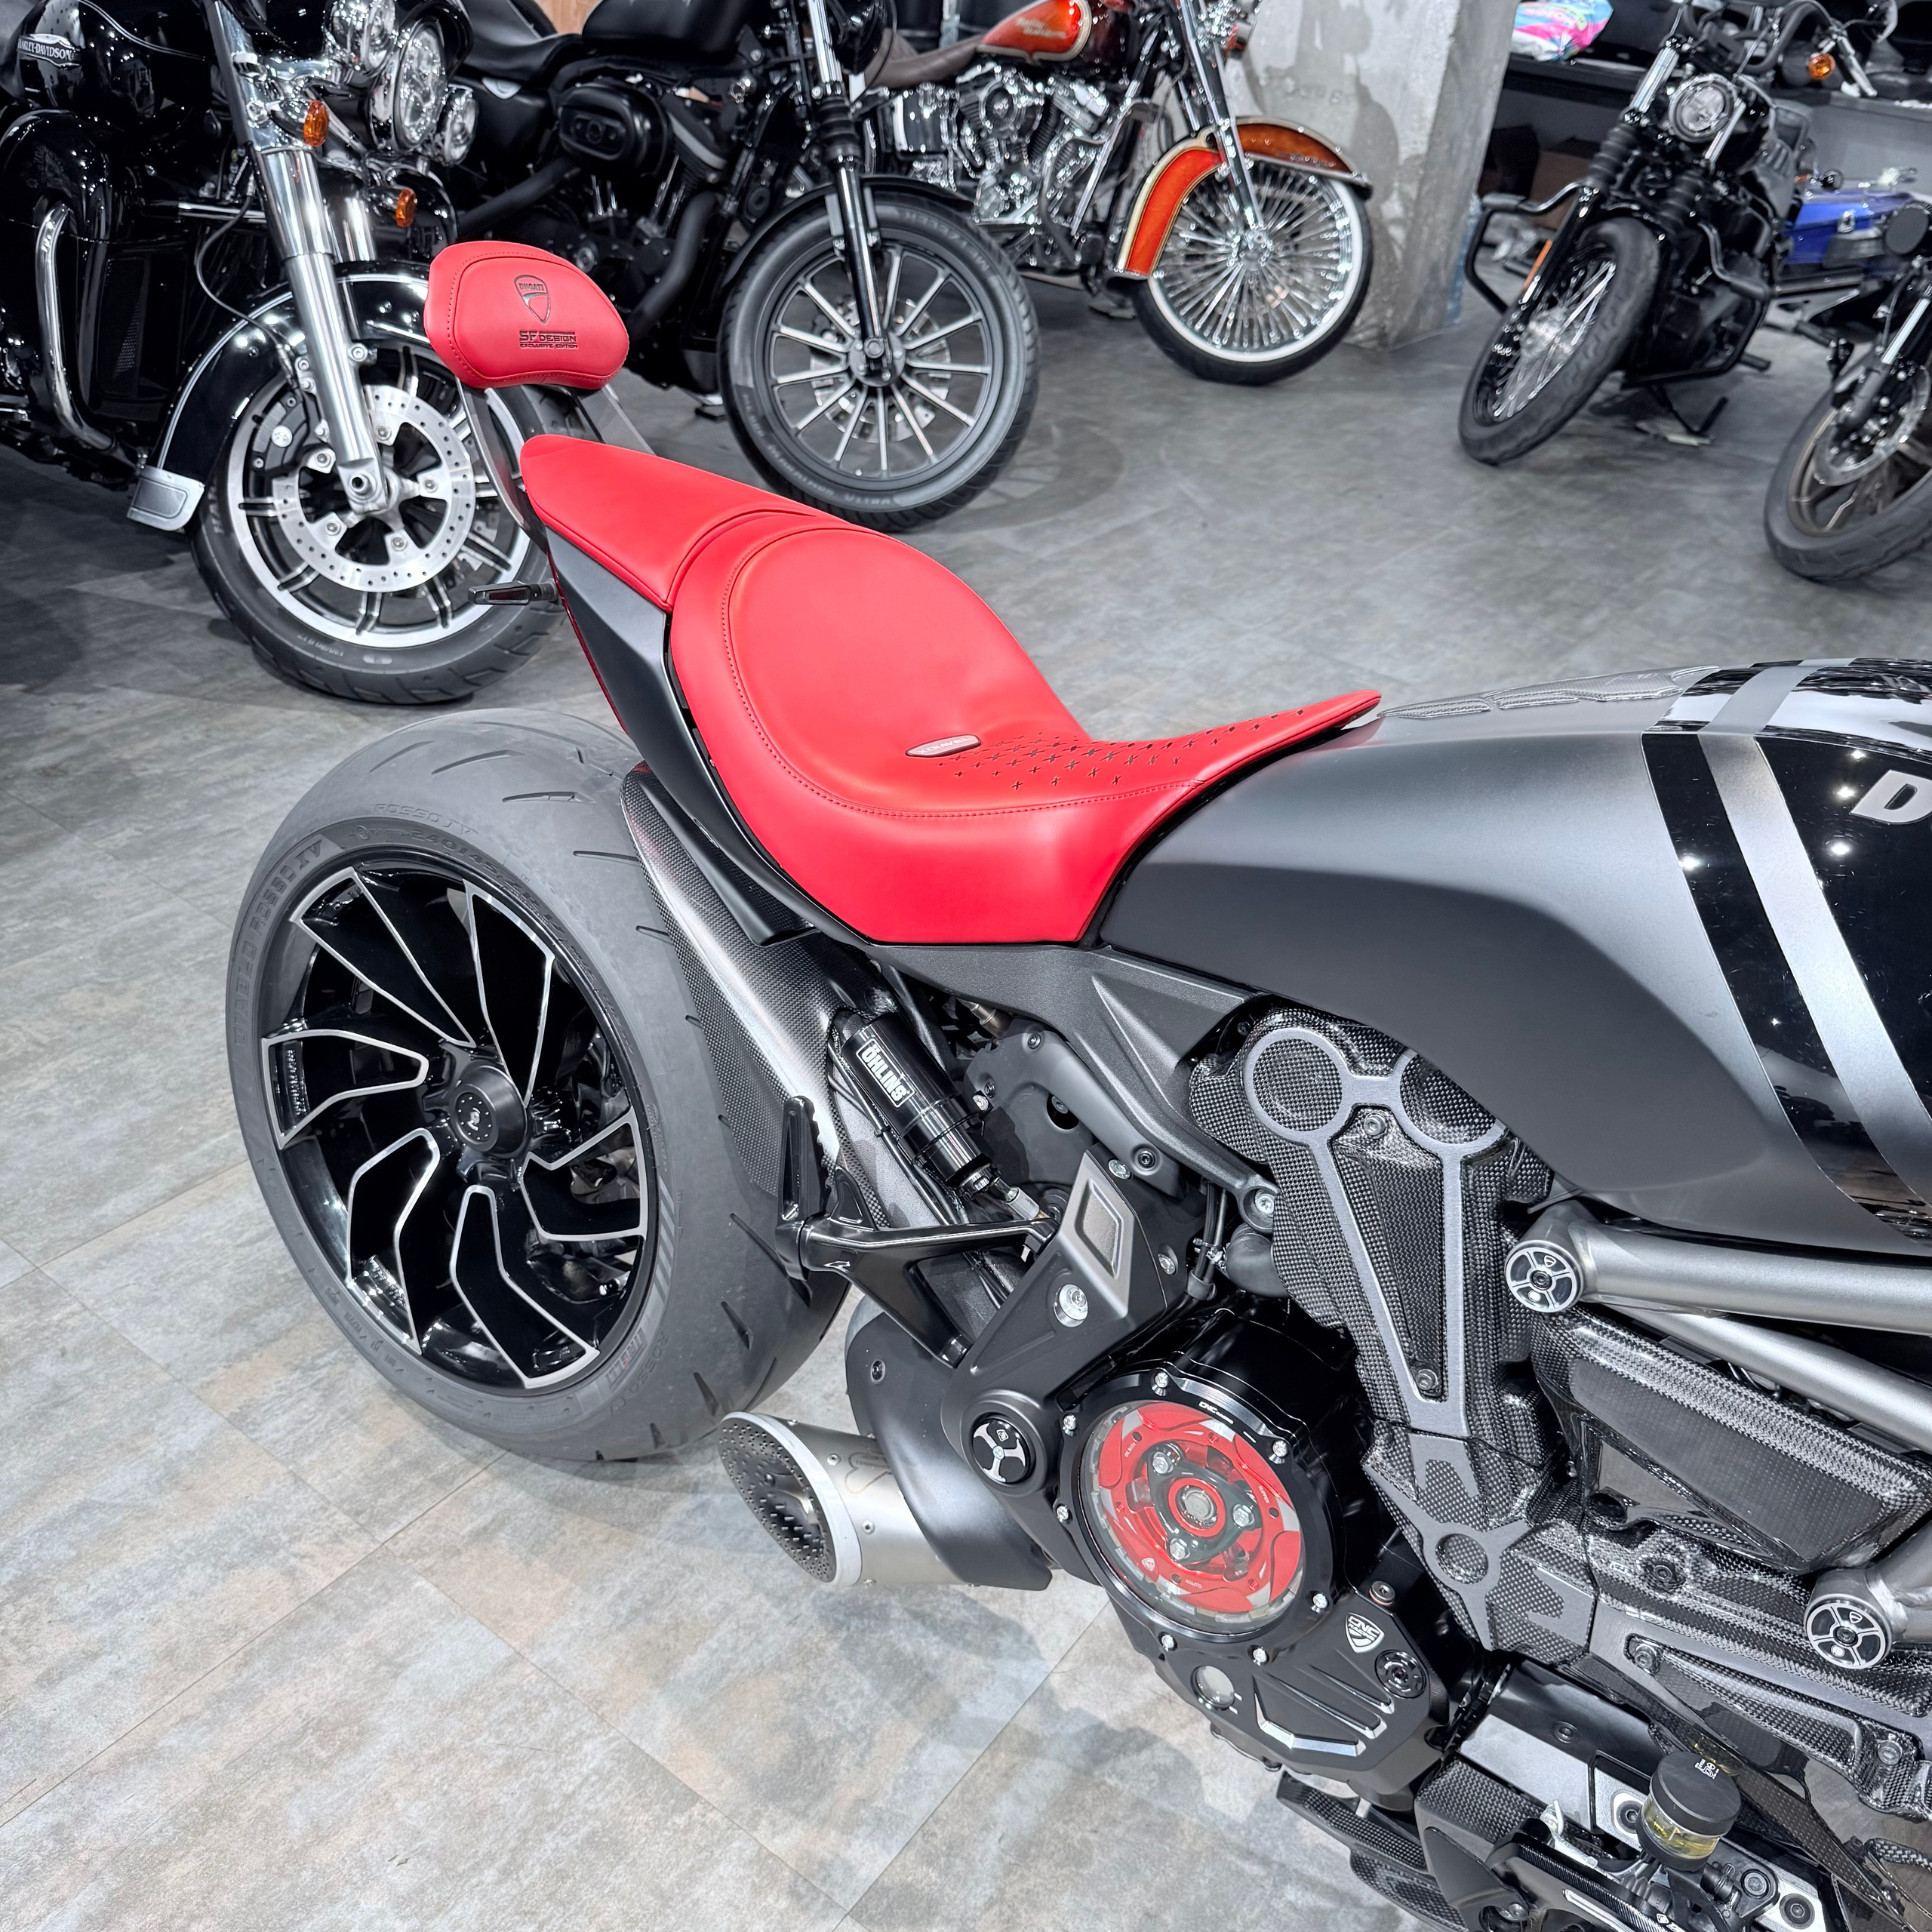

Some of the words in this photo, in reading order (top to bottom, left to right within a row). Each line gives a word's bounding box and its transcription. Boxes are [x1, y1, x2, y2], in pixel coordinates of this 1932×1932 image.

[518, 283, 544, 291] DUCATI
[519, 331, 537, 342] SF
[373, 802, 443, 823] ROSSO
[232, 940, 258, 1047] DIABLO
[248, 863, 298, 937] ROSSO
[861, 1043, 908, 1102] ÖHLINS
[605, 1326, 650, 1393] PIRELLI
[1198, 1401, 1218, 1414] CNC
[1257, 1484, 1270, 1504] SLIPPER
[1185, 1578, 1203, 1588] CLUTCH
[1347, 1615, 1380, 1638] CNC
